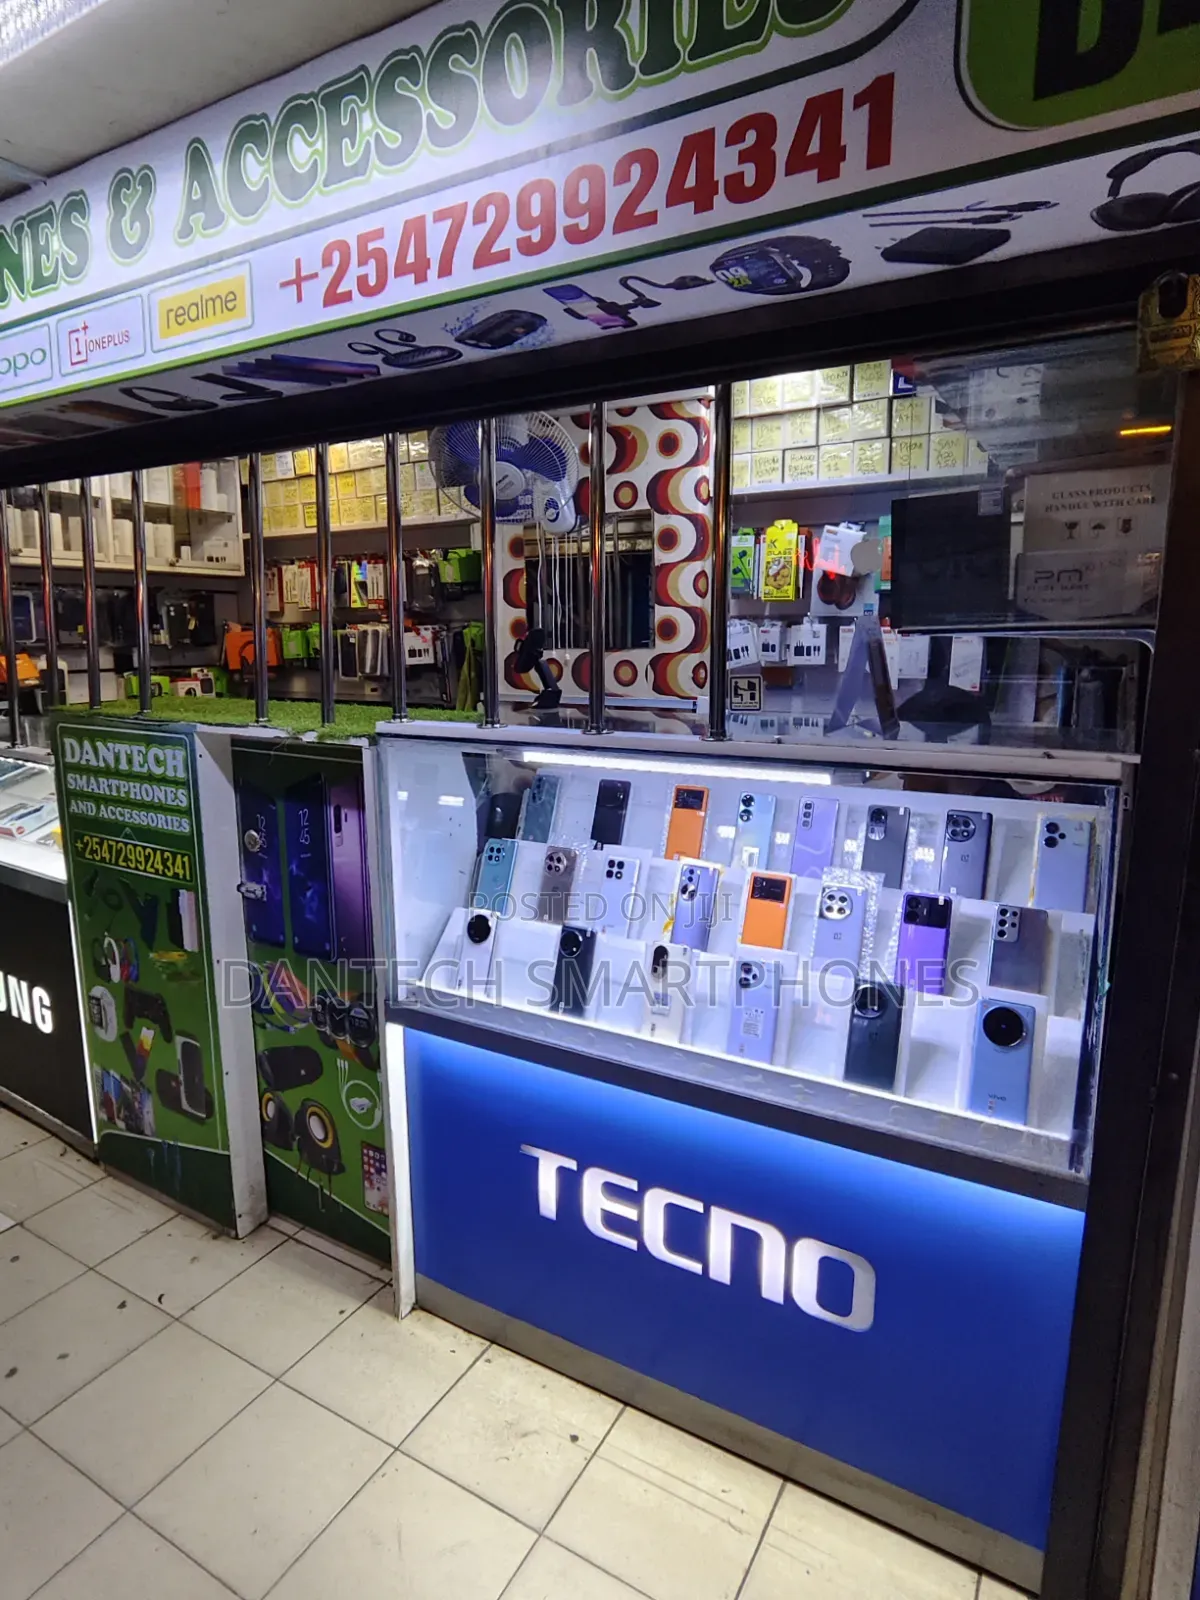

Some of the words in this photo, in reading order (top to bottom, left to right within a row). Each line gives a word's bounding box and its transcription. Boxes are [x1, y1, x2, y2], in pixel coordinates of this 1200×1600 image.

[279, 72, 895, 309] +254729924341
[108, 165, 156, 263] &
[166, 290, 237, 329] realme
[88, 330, 130, 352] ONEPLUS
[1051, 489, 1087, 500] GLASS
[1088, 483, 1151, 497] PRODUCTS
[1094, 499, 1125, 509] WITH
[1126, 495, 1157, 506] CARE
[63, 738, 186, 778] DANTECH
[67, 773, 187, 807] SMARTPHONES
[69, 799, 97, 816] AND
[98, 804, 190, 833] ACCESSORIES
[298, 808, 310, 826] 12
[299, 829, 310, 845] 45
[75, 835, 191, 881] +254729924341
[519, 1143, 876, 1333] TECNO
